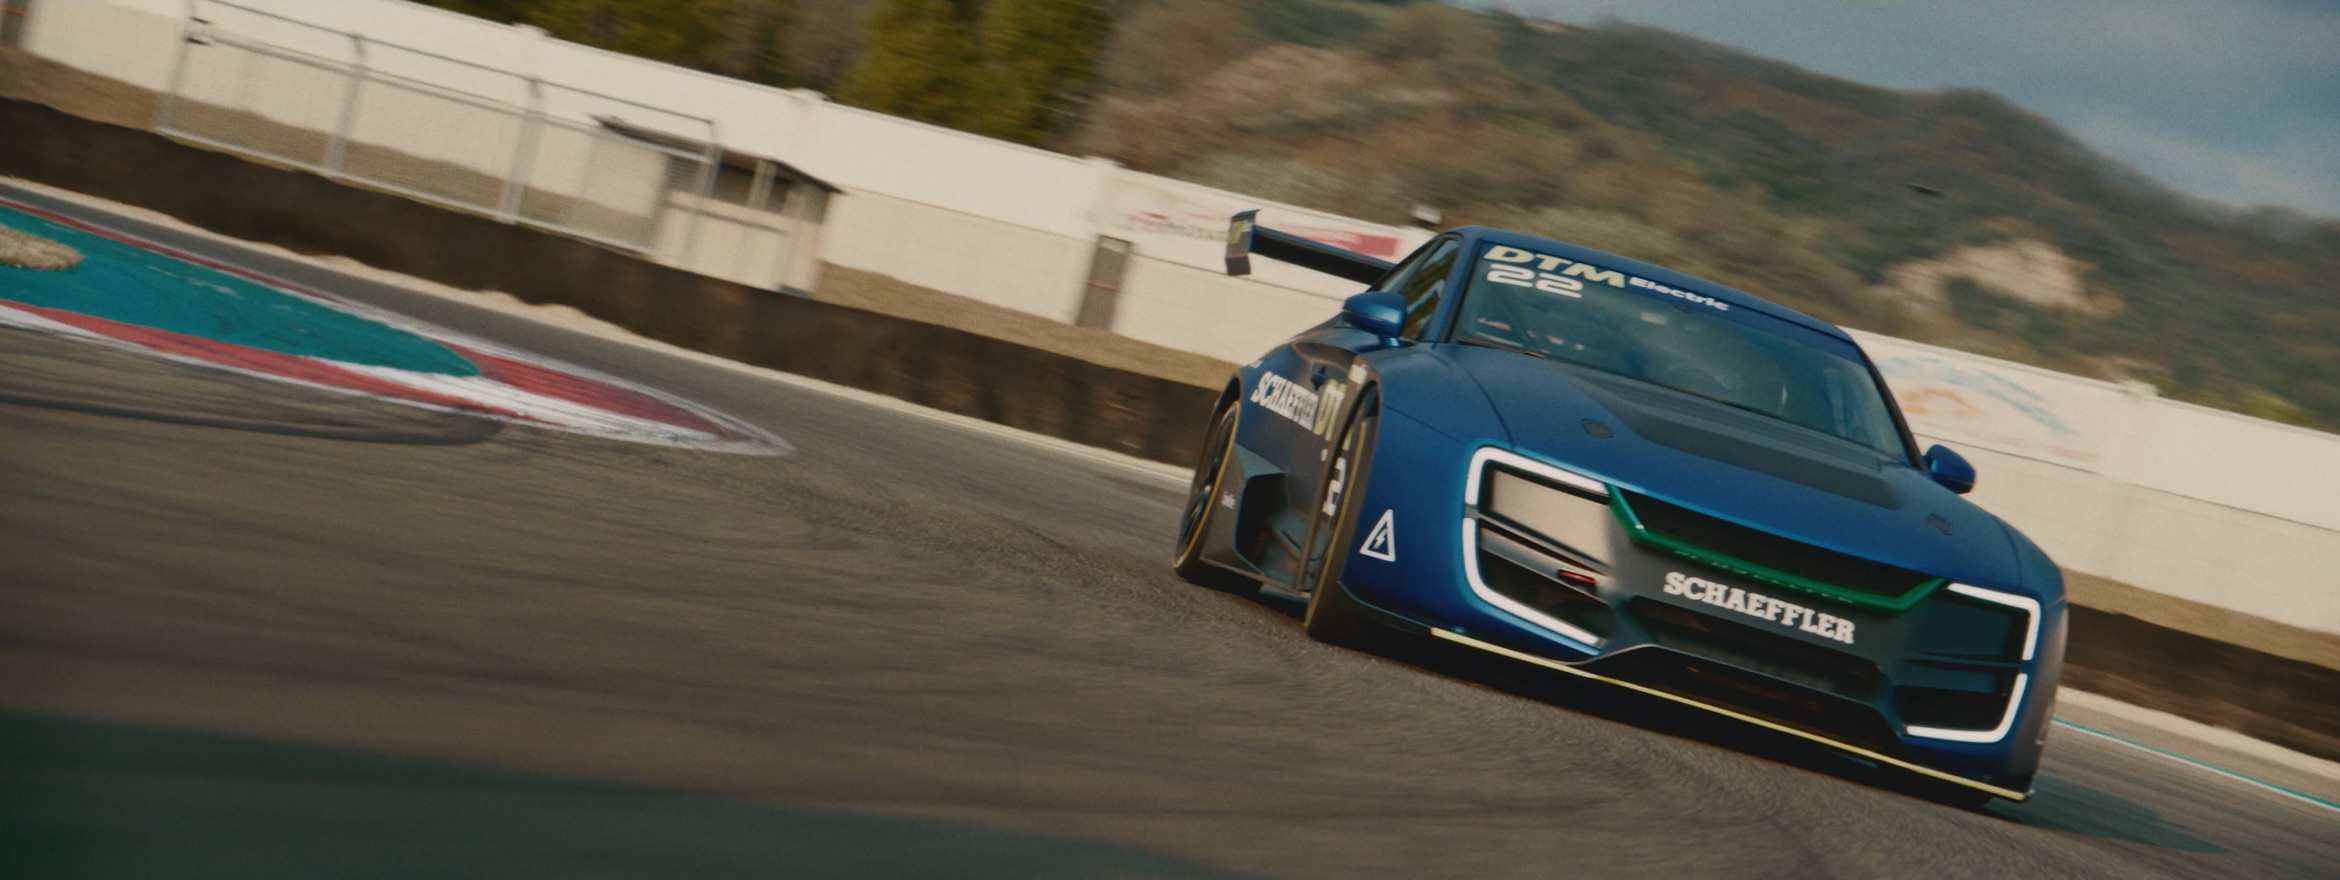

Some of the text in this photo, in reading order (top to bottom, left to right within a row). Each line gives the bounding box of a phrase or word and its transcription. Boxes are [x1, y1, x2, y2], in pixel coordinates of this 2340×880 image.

[1483, 245, 1729, 311] DTM Electric
[1486, 263, 1583, 298] 22
[1663, 571, 1856, 644] SCHAEFFLER
